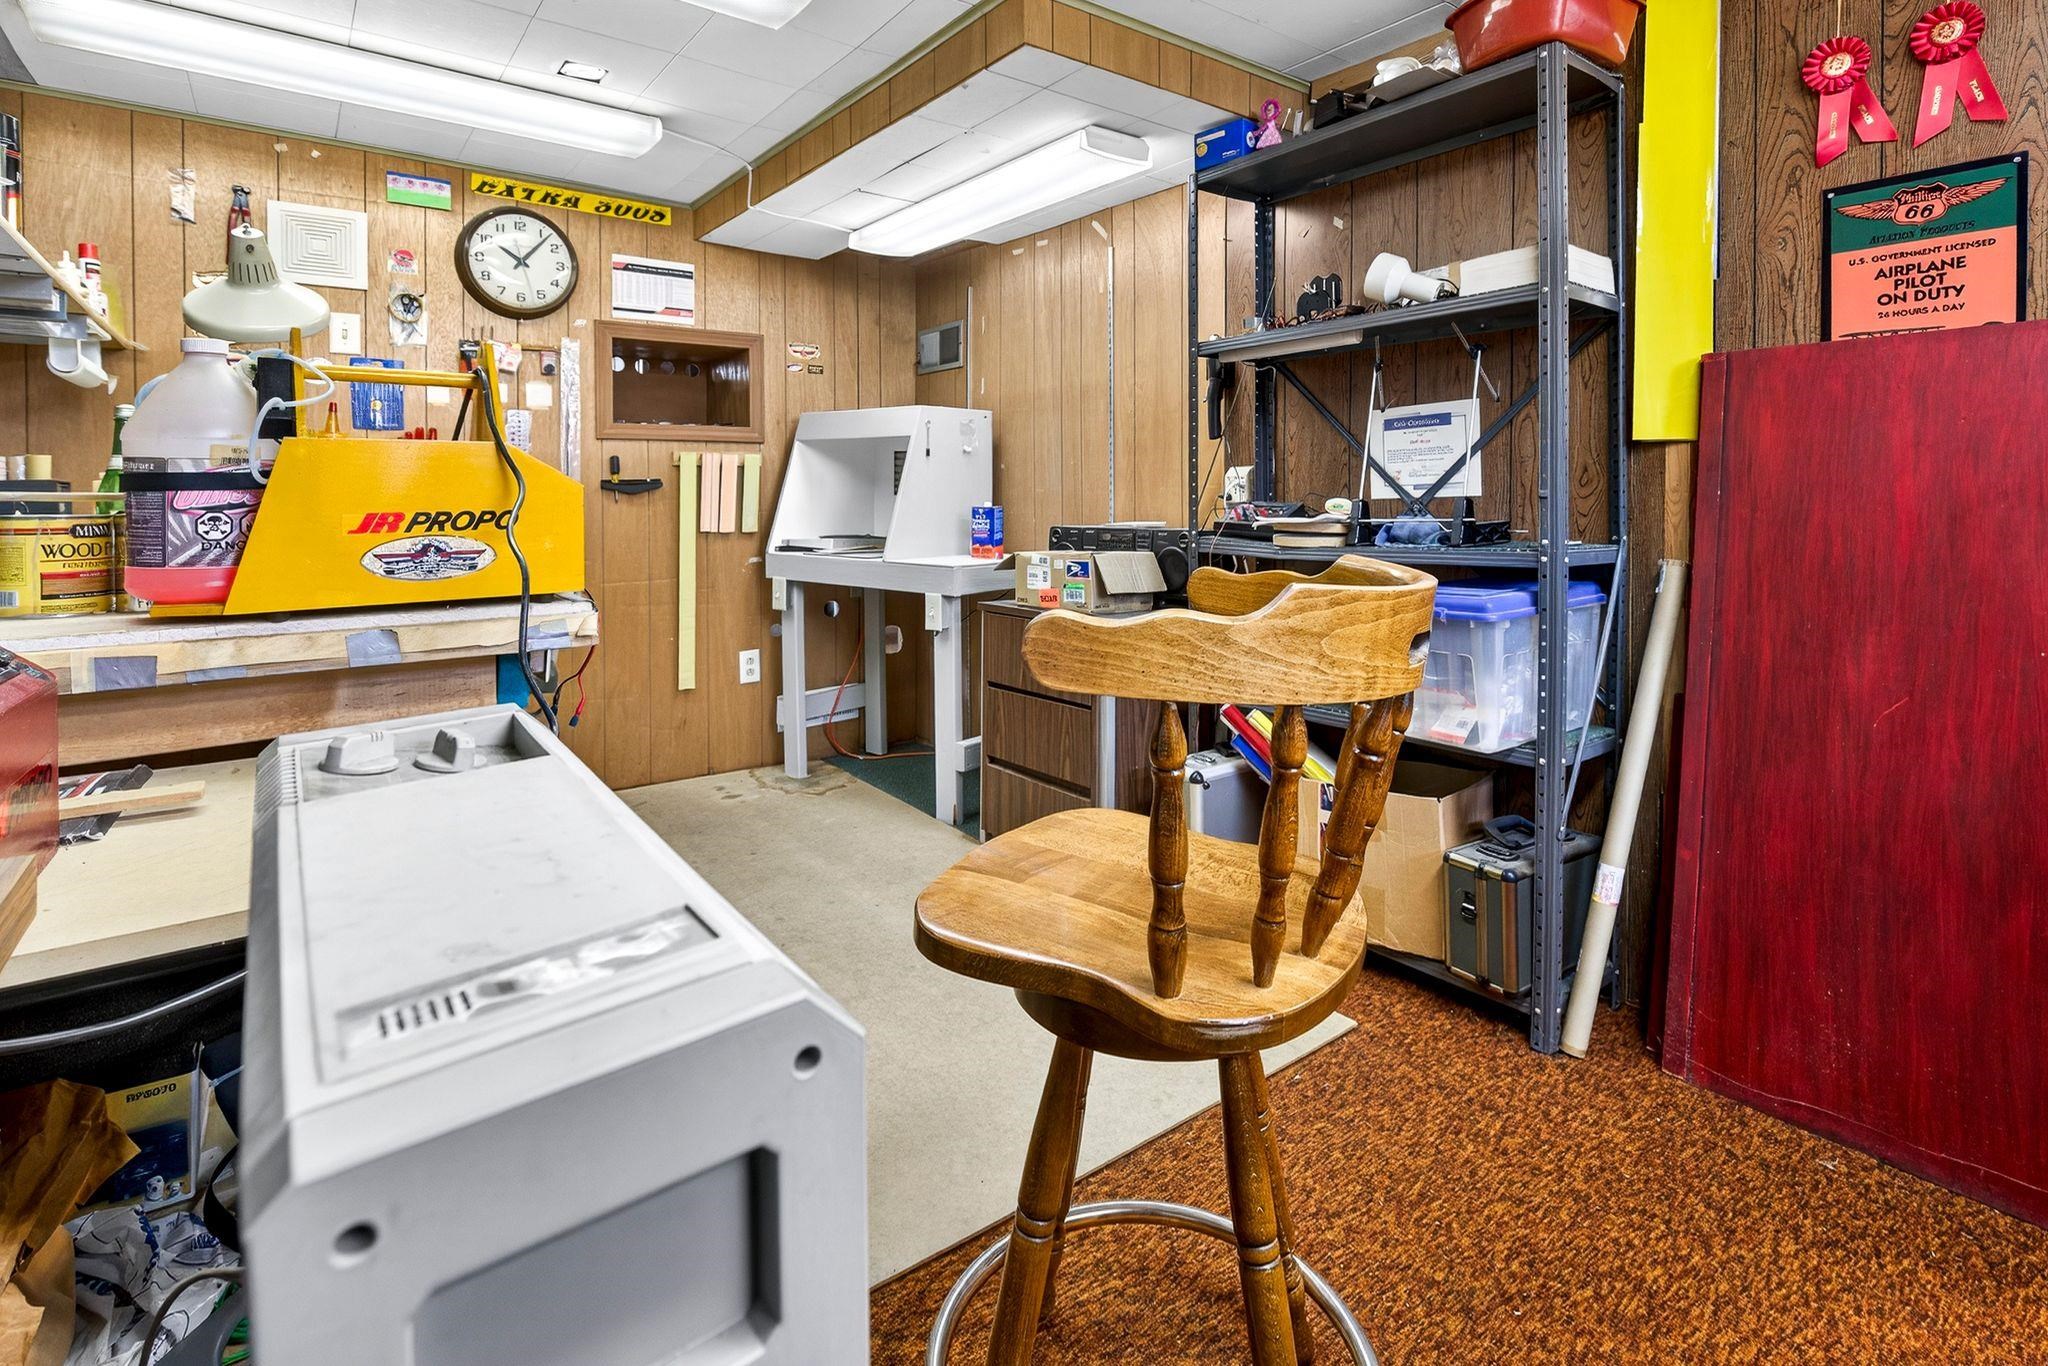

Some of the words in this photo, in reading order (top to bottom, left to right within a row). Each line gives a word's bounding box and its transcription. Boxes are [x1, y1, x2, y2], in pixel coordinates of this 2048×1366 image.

[1904, 203, 1936, 220] 66
[496, 223, 505, 233] 11
[514, 221, 527, 232] 12
[549, 243, 560, 254] 2
[1848, 257, 1869, 267] U.S.
[1871, 246, 1943, 263] GOVERNMENT
[1945, 237, 1997, 252] LICENSED
[555, 261, 566, 272] 3
[1874, 255, 1967, 281] AIRPLANE
[549, 279, 560, 288] 4
[1893, 272, 1947, 291] PILOT
[496, 285, 506, 295] 7
[516, 291, 526, 302] 6
[536, 289, 546, 300] 5
[1877, 291, 1907, 307] ON
[1914, 284, 1966, 302] DUTY
[1892, 305, 1929, 318] HOURS
[1931, 305, 1940, 313] A
[1942, 302, 1966, 313] DAY
[347, 512, 406, 535] JR
[41, 542, 102, 559] WOOD
